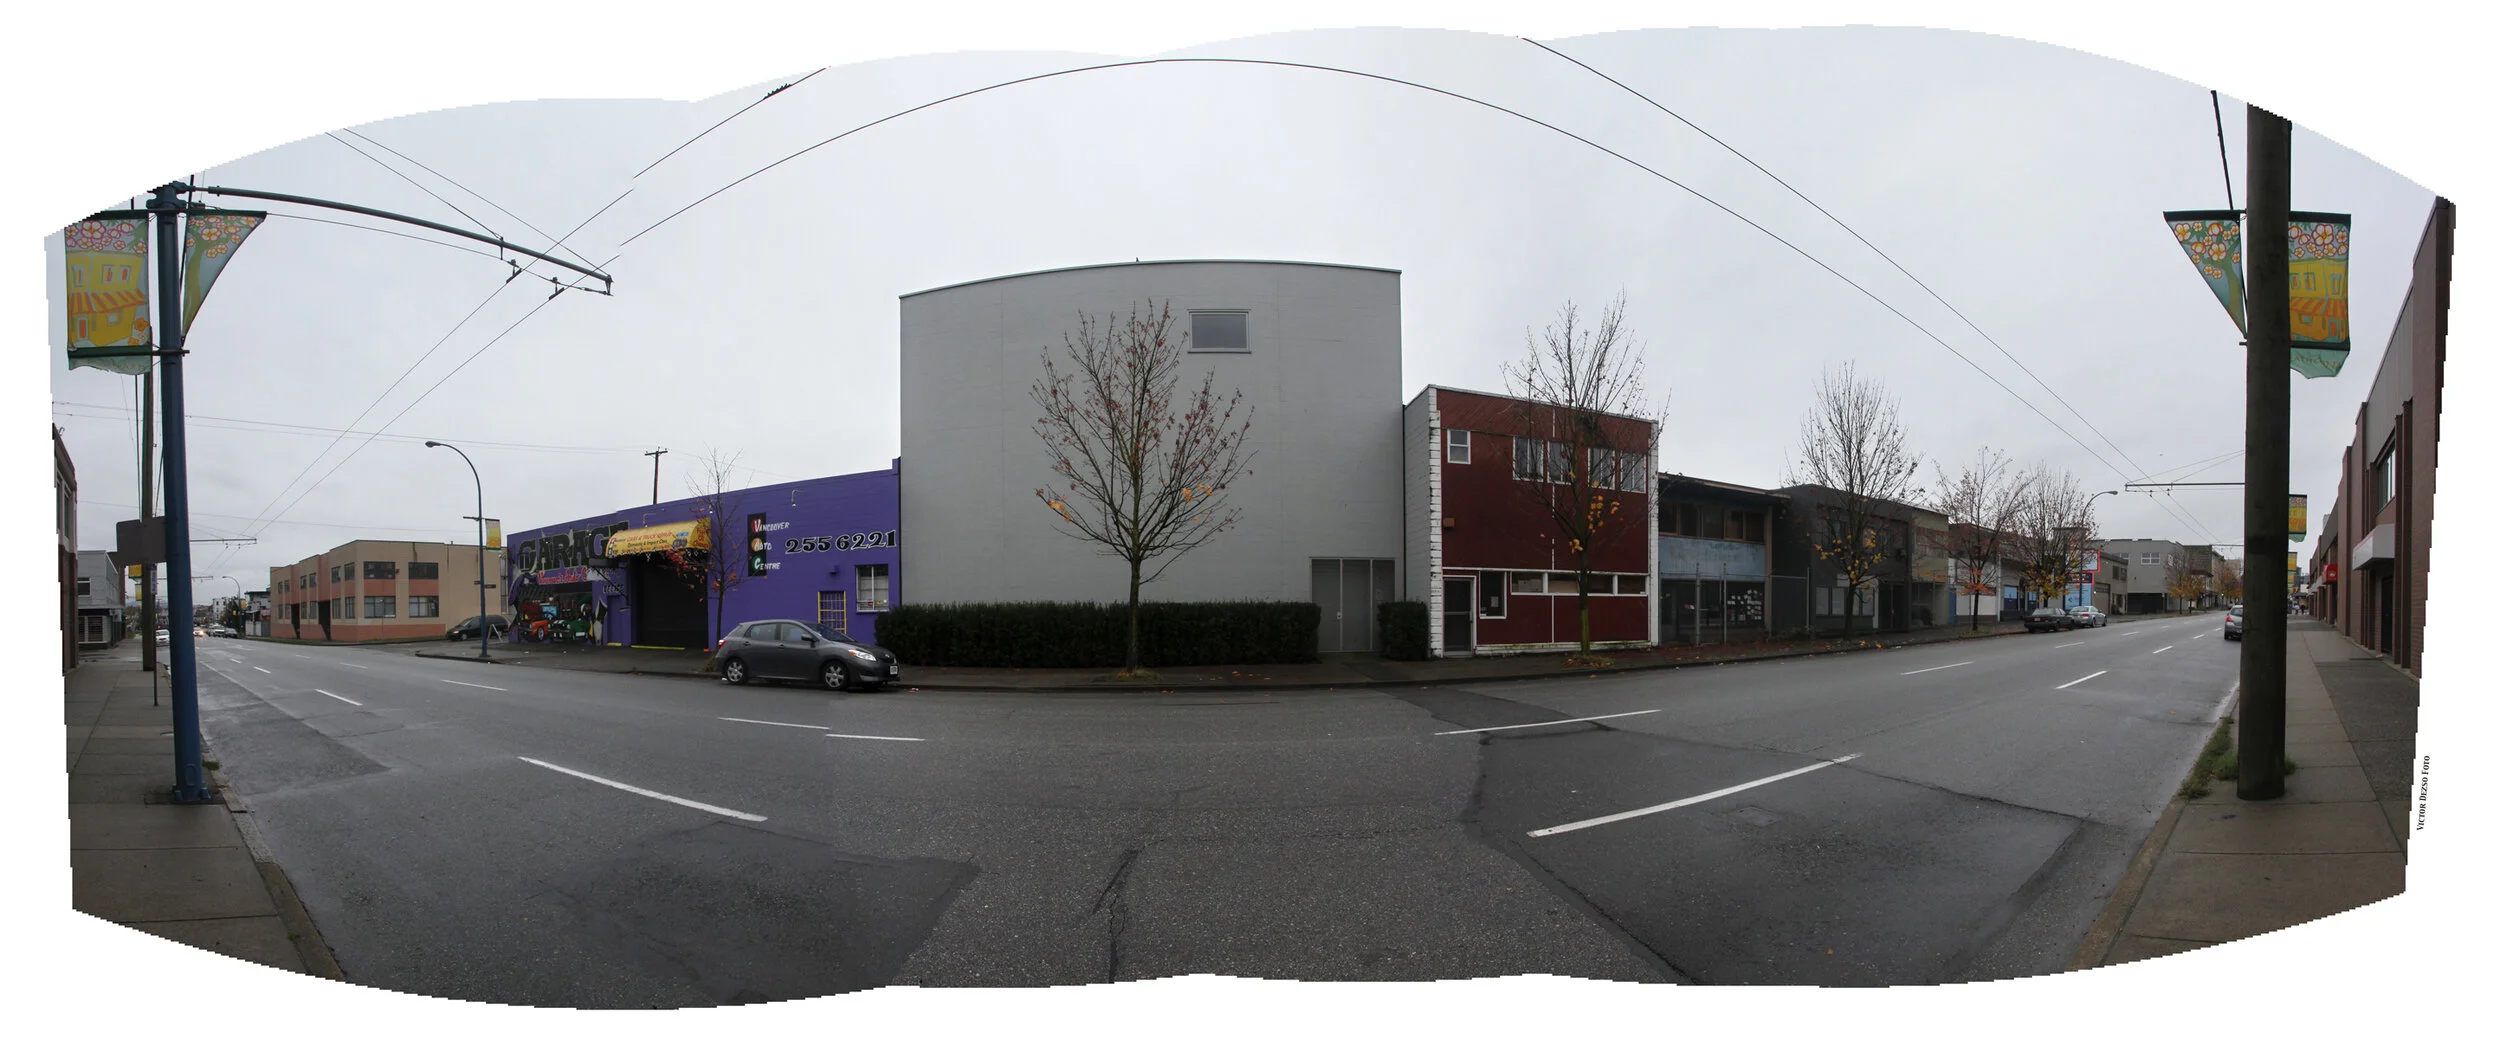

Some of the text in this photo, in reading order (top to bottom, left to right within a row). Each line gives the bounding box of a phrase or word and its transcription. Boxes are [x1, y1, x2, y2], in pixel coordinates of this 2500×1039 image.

[753, 538, 772, 551] AUTO
[785, 529, 896, 554] 255 6221
[754, 558, 781, 570] CENTRE
